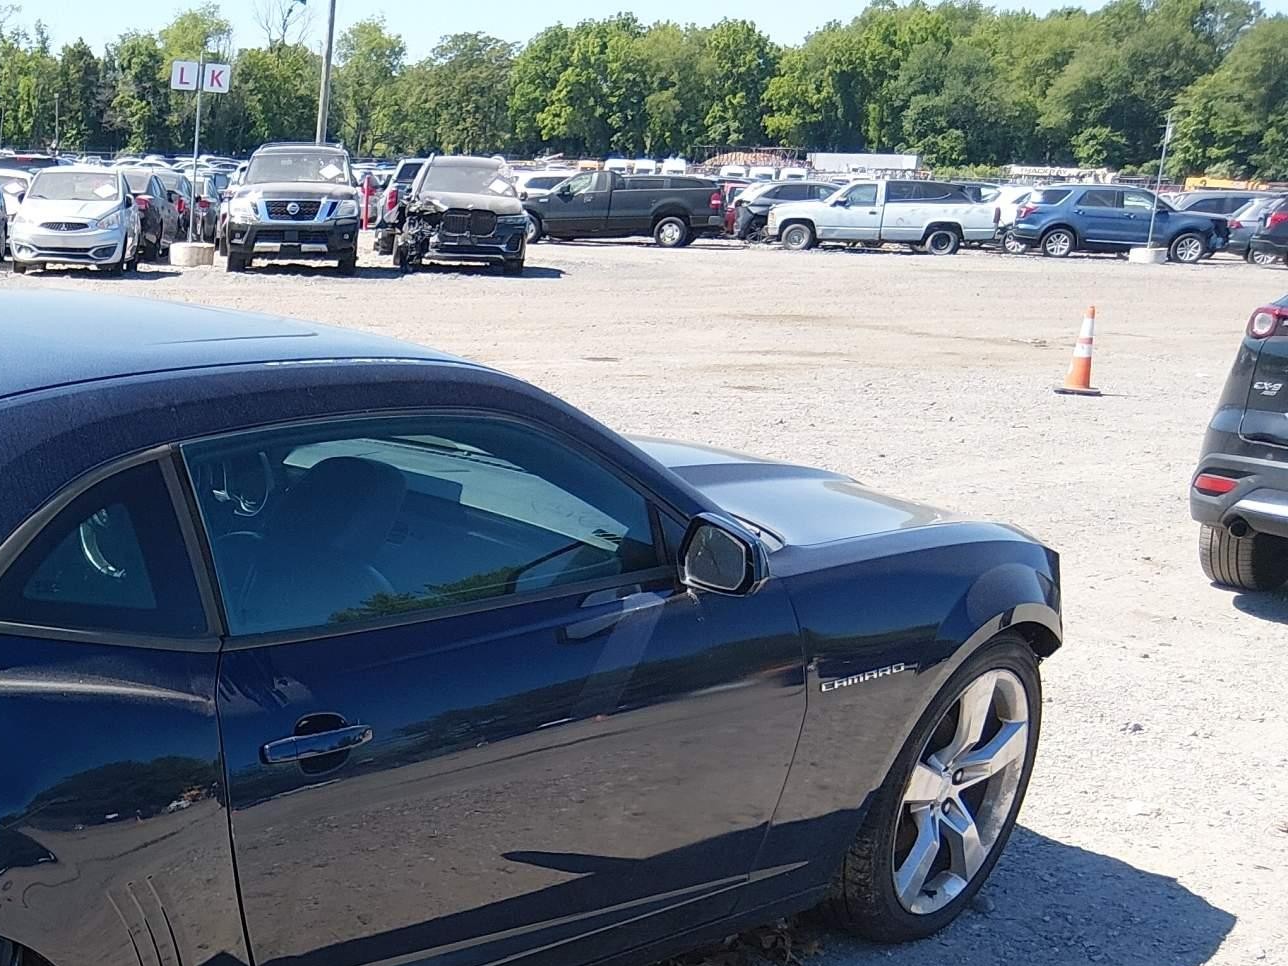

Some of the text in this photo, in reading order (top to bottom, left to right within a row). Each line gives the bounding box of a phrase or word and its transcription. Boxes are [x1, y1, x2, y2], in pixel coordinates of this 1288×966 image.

[179, 67, 190, 85] L
[210, 70, 224, 87] K
[821, 663, 905, 692] CAMARO
